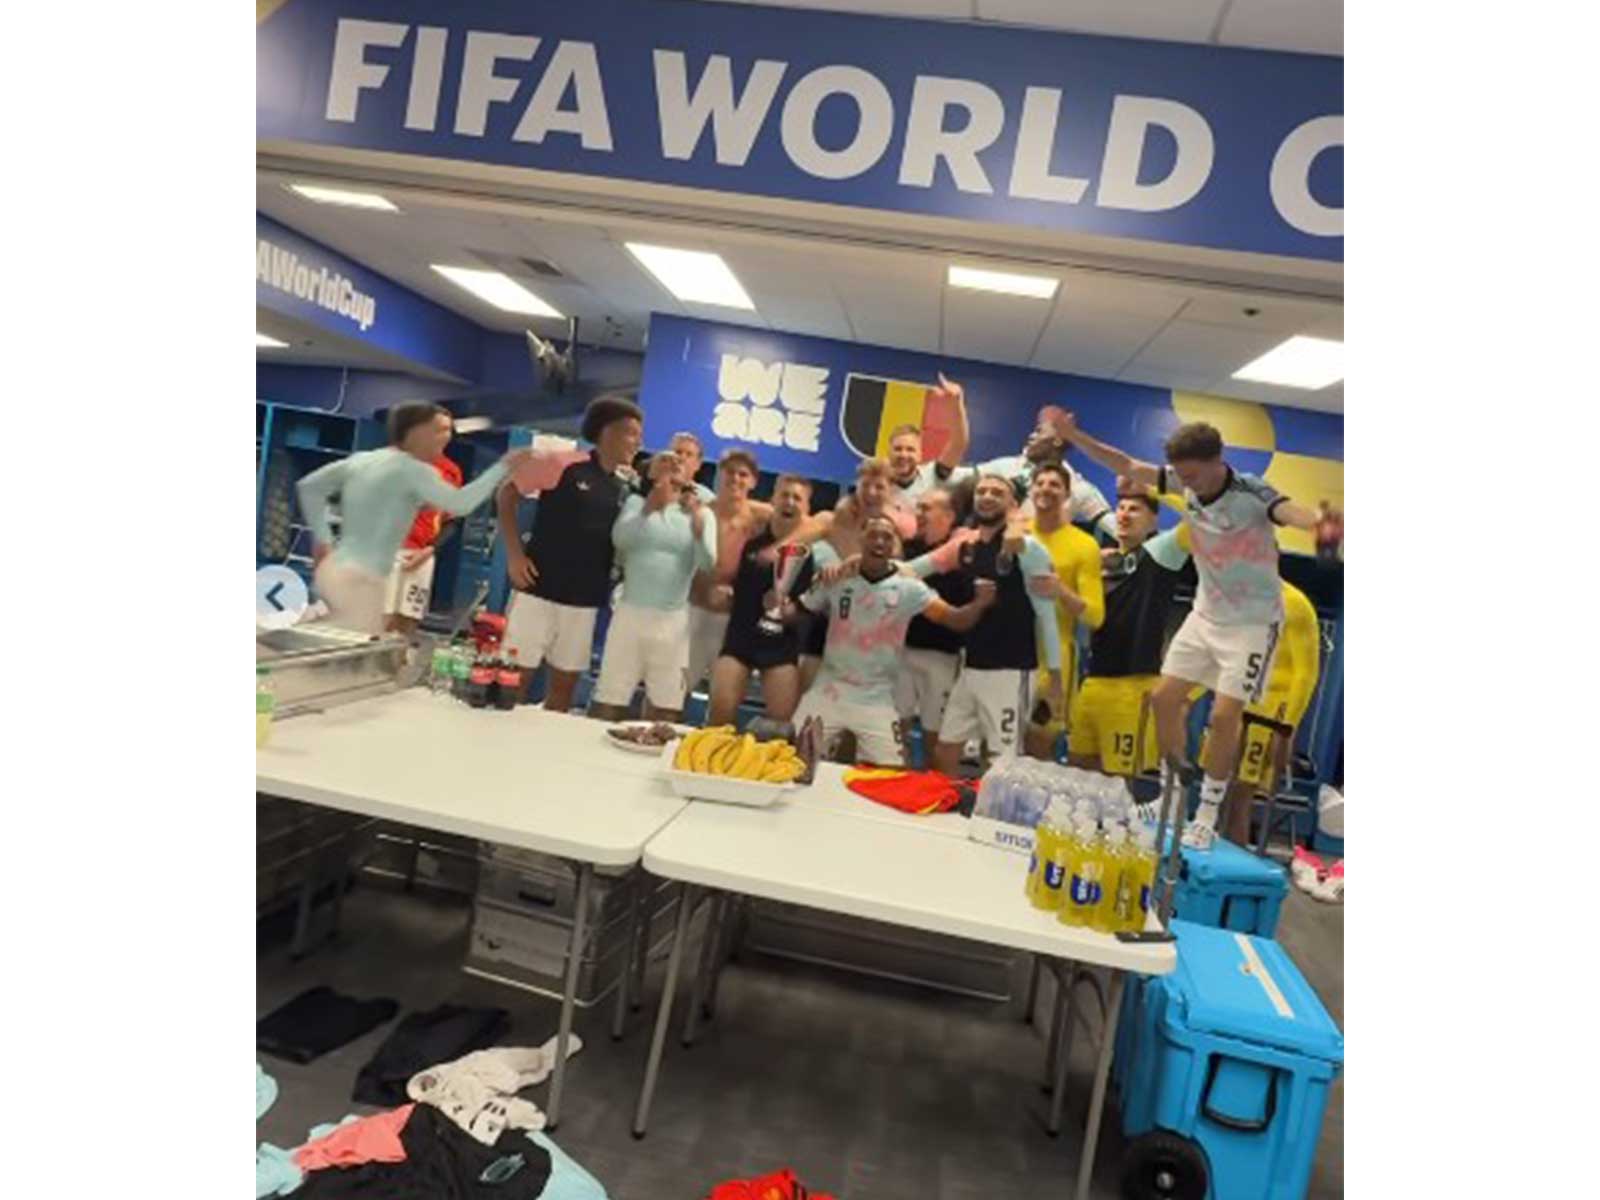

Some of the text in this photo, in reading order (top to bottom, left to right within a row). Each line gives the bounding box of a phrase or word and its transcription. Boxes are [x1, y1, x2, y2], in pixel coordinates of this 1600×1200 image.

[326, 18, 613, 152] FIFA
[653, 48, 1215, 213] WORLD
[718, 353, 830, 416] WE
[839, 596, 851, 619] 8
[1245, 652, 1262, 679] 5
[1001, 707, 1015, 733] 2
[1113, 731, 1134, 756] 13
